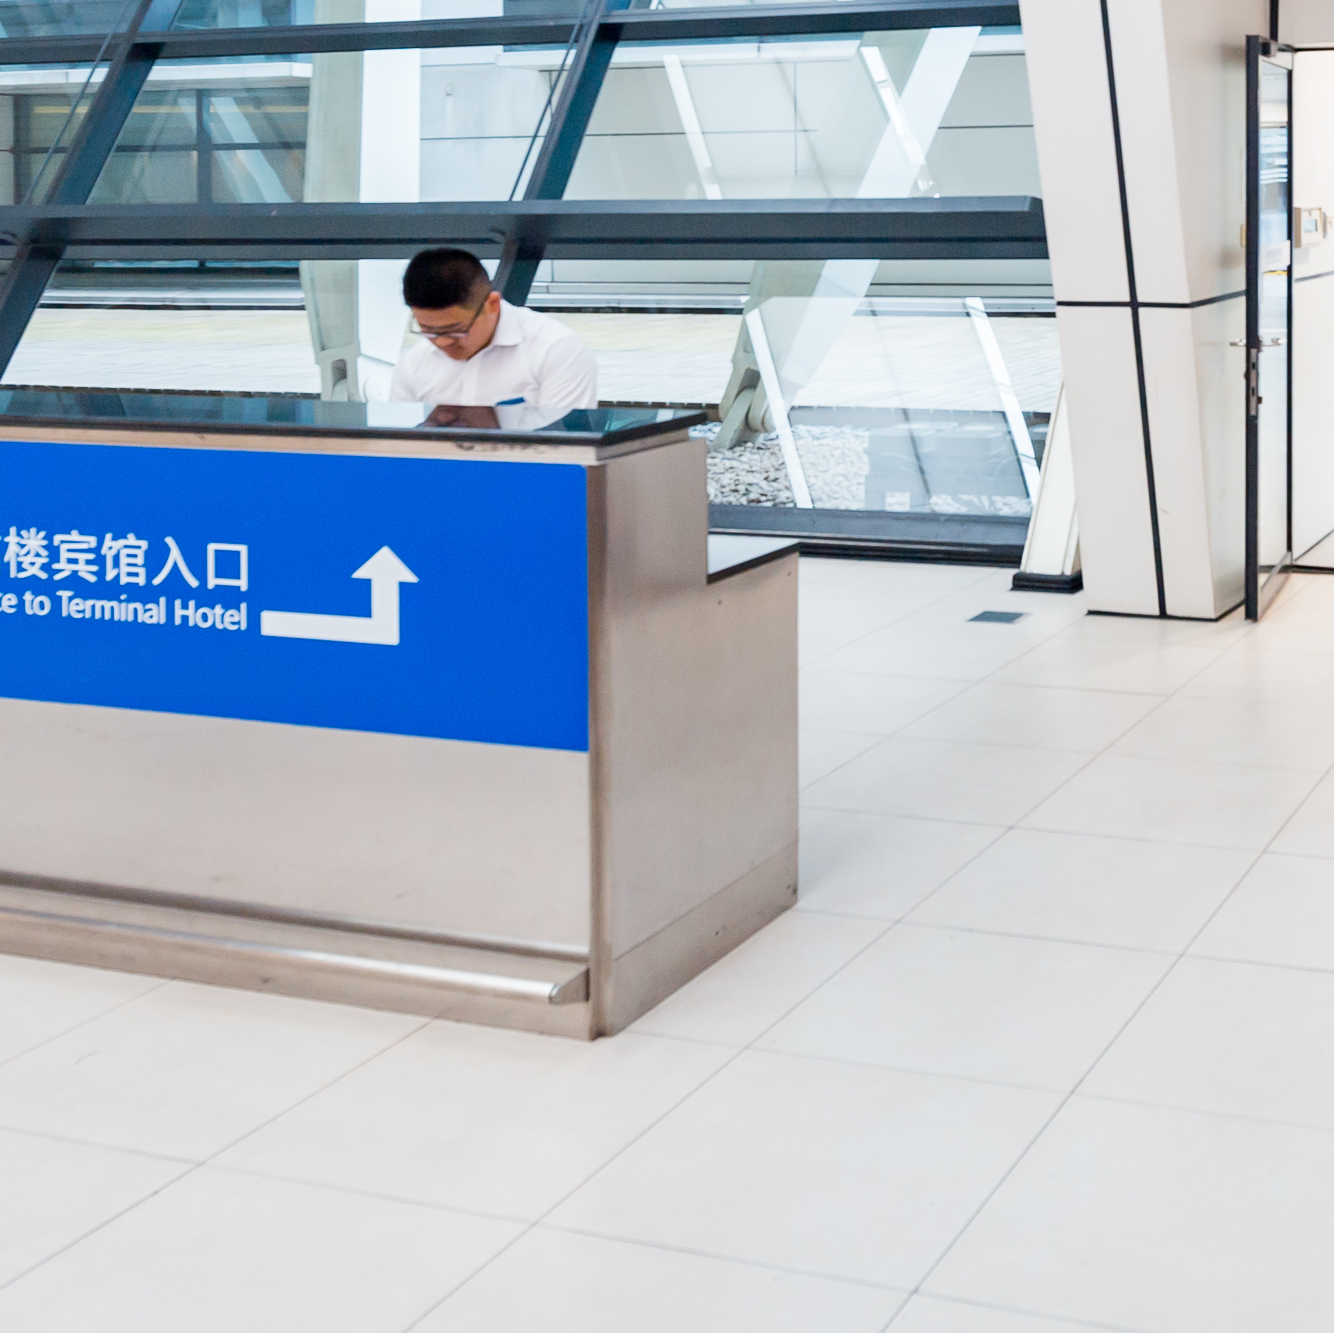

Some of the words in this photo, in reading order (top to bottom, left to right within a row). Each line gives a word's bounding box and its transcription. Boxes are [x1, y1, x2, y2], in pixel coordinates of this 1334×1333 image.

[23, 591, 51, 615] to
[56, 591, 166, 624] Terminal
[175, 599, 247, 630] Hotel
